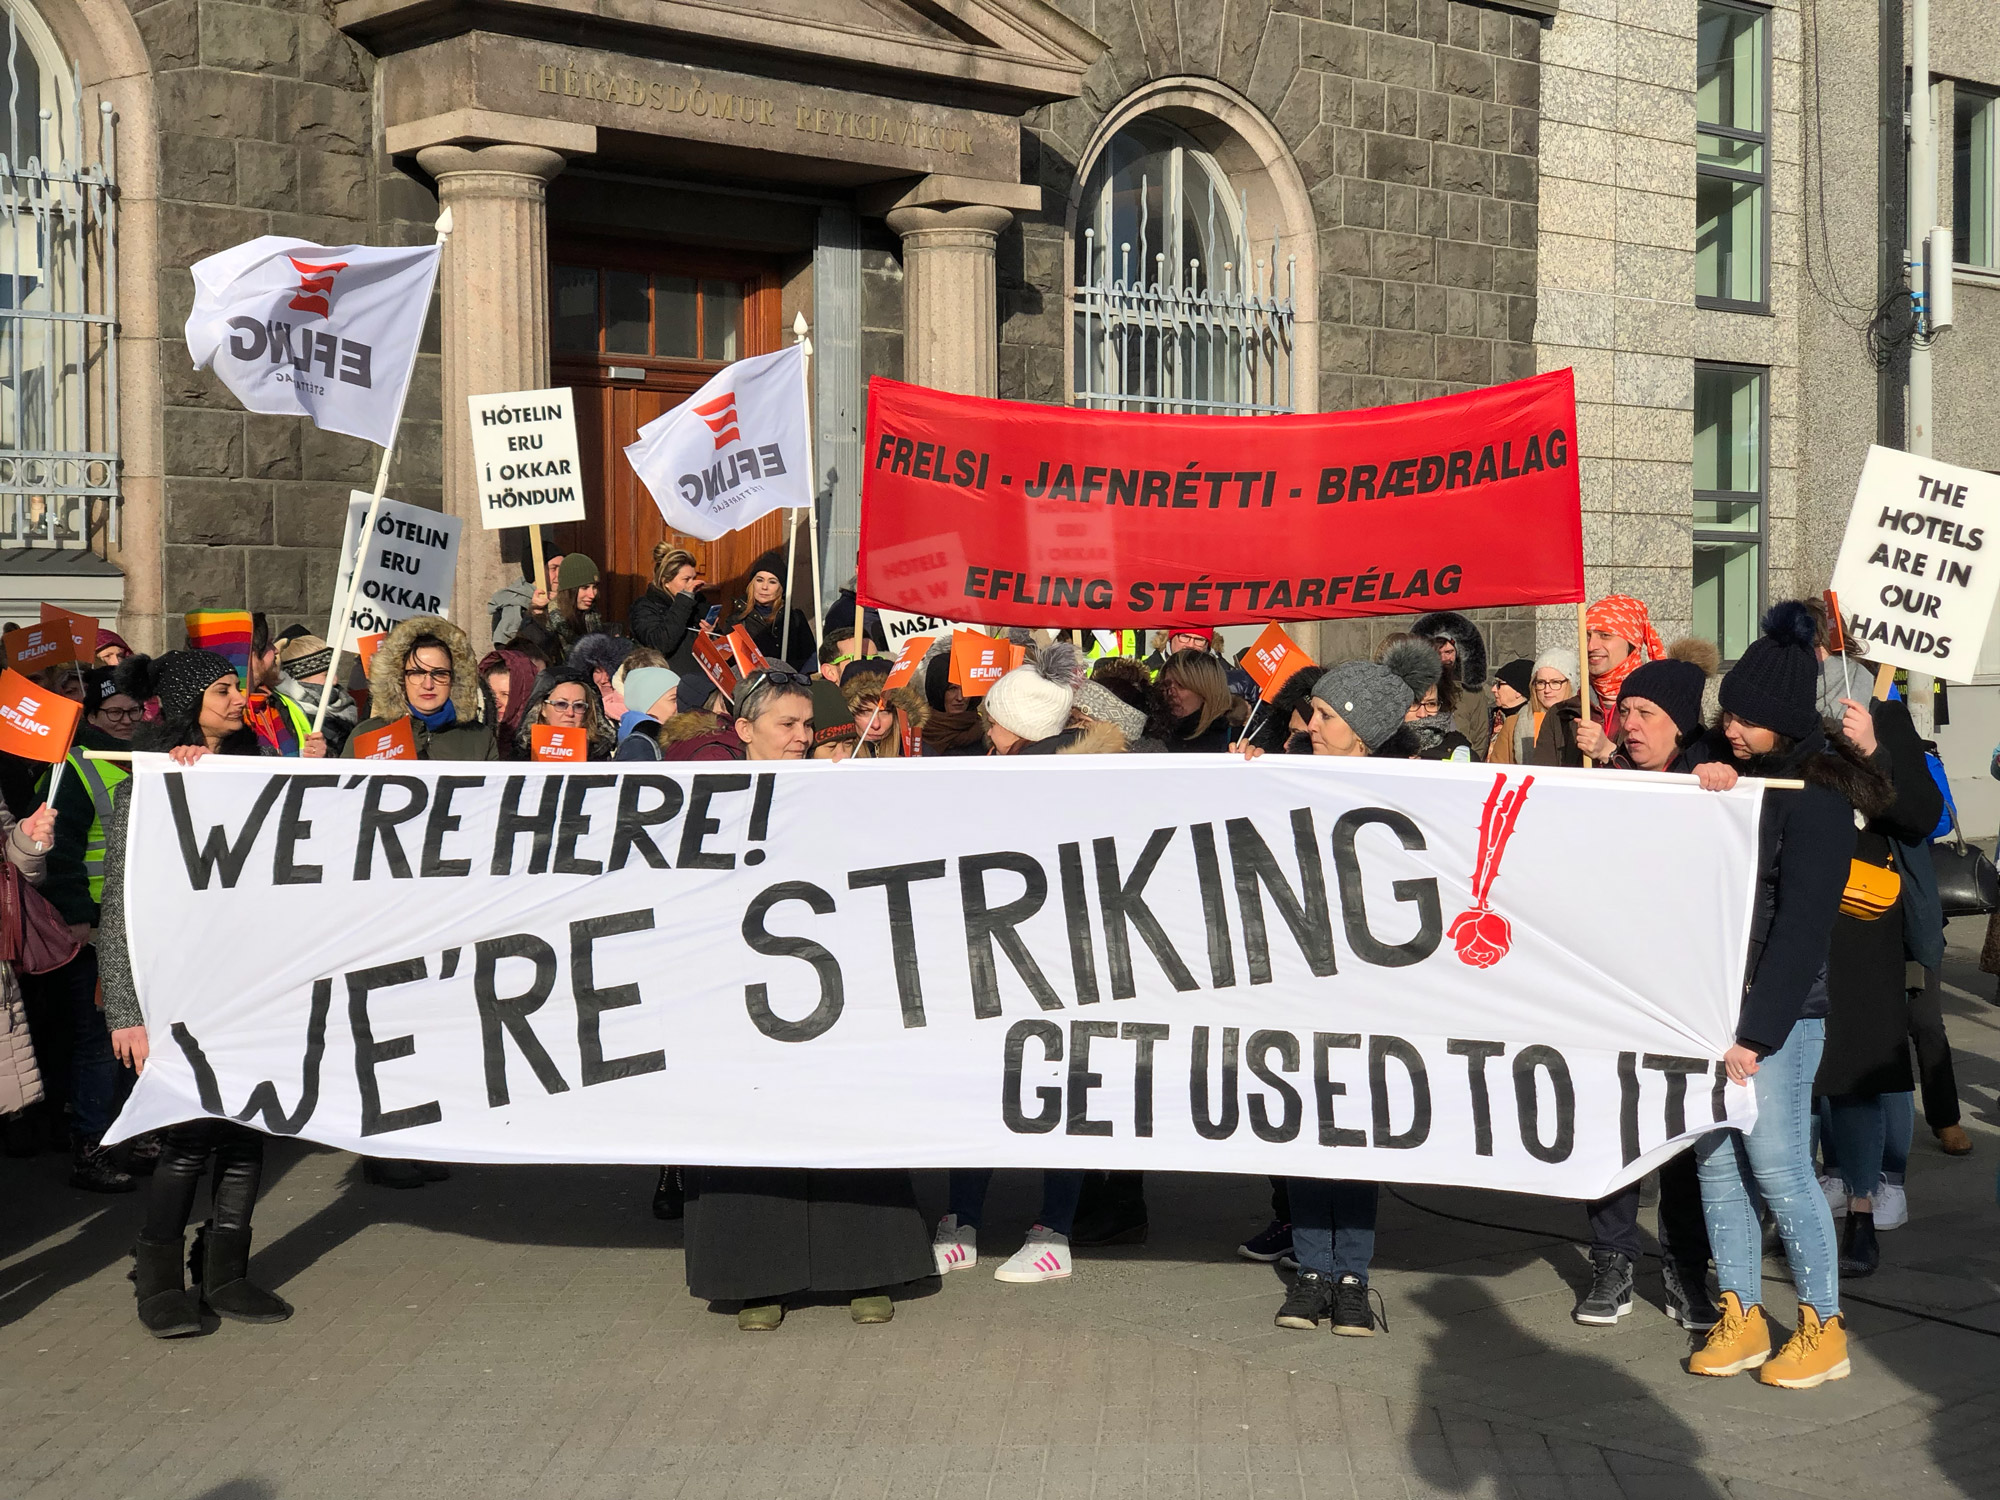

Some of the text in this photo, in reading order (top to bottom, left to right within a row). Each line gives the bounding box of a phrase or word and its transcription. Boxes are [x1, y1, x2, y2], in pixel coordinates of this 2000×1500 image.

[537, 61, 975, 157] HÉRAÐSDÓMUR REYKJAVÍKUR
[481, 404, 562, 426] HÓTELIN
[507, 434, 543, 452] ERU
[485, 459, 571, 482] Í OKKAR
[875, 434, 990, 490] FRELSI
[1025, 461, 1277, 509] JAFNRÉTTI
[1317, 429, 1568, 505] BRÆÐRALAG
[488, 486, 575, 510] HÖNDUM
[1918, 474, 1969, 509] THE
[1877, 505, 1984, 551] HOTELS
[380, 550, 421, 575] ERU
[1867, 543, 1973, 588] ARE IN
[362, 579, 441, 614] OKKAR
[964, 564, 1463, 613] EFLING STÉTTARFÉLAG
[1879, 584, 1941, 619] OUR
[18, 642, 57, 661] EFLING
[1850, 613, 1953, 659] HANDS
[969, 666, 1002, 679] EFLING
[1255, 648, 1277, 674] EFLIN
[0, 704, 50, 736] EFLING
[539, 746, 574, 757] EFLING
[164, 772, 777, 891] WE'RE HERE!
[170, 907, 666, 1138] WE'RE
[1002, 1019, 1170, 1138] GET
[1190, 1025, 1432, 1150] USED
[1446, 1037, 1577, 1165] TO
